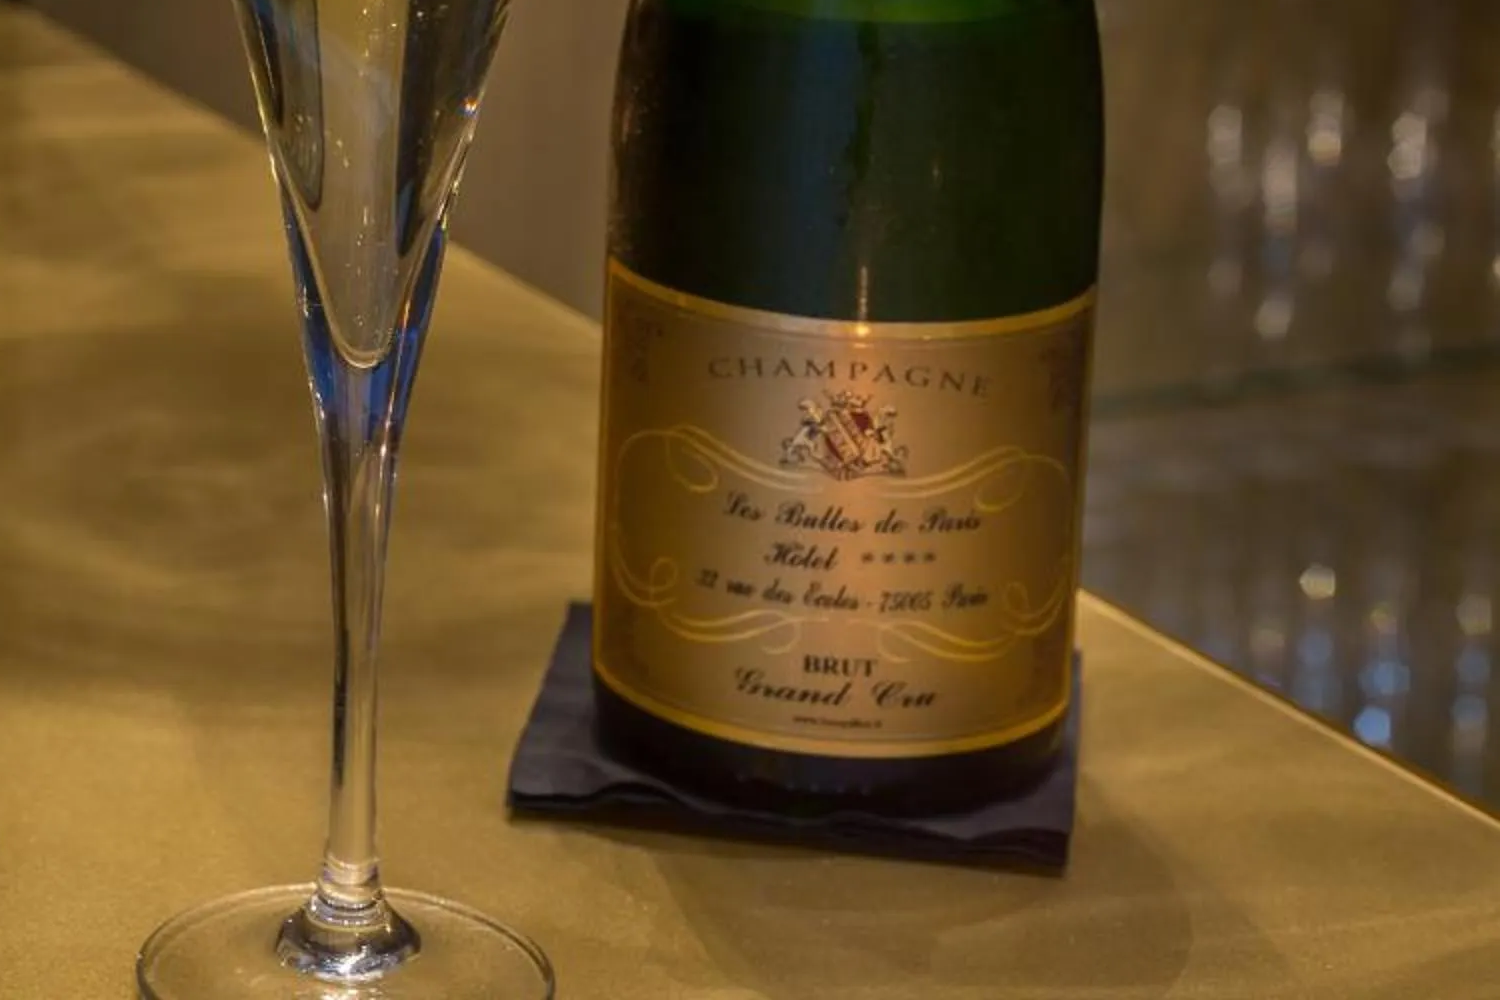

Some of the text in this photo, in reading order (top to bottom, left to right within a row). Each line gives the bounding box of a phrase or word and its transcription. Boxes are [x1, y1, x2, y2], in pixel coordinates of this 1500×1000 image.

[707, 357, 994, 398] CHAMPAGNE
[775, 500, 863, 533] Bulles
[874, 509, 908, 534] de
[918, 506, 982, 534] Paris
[803, 654, 880, 678] BRUT
[734, 664, 938, 710] Grand Cru
